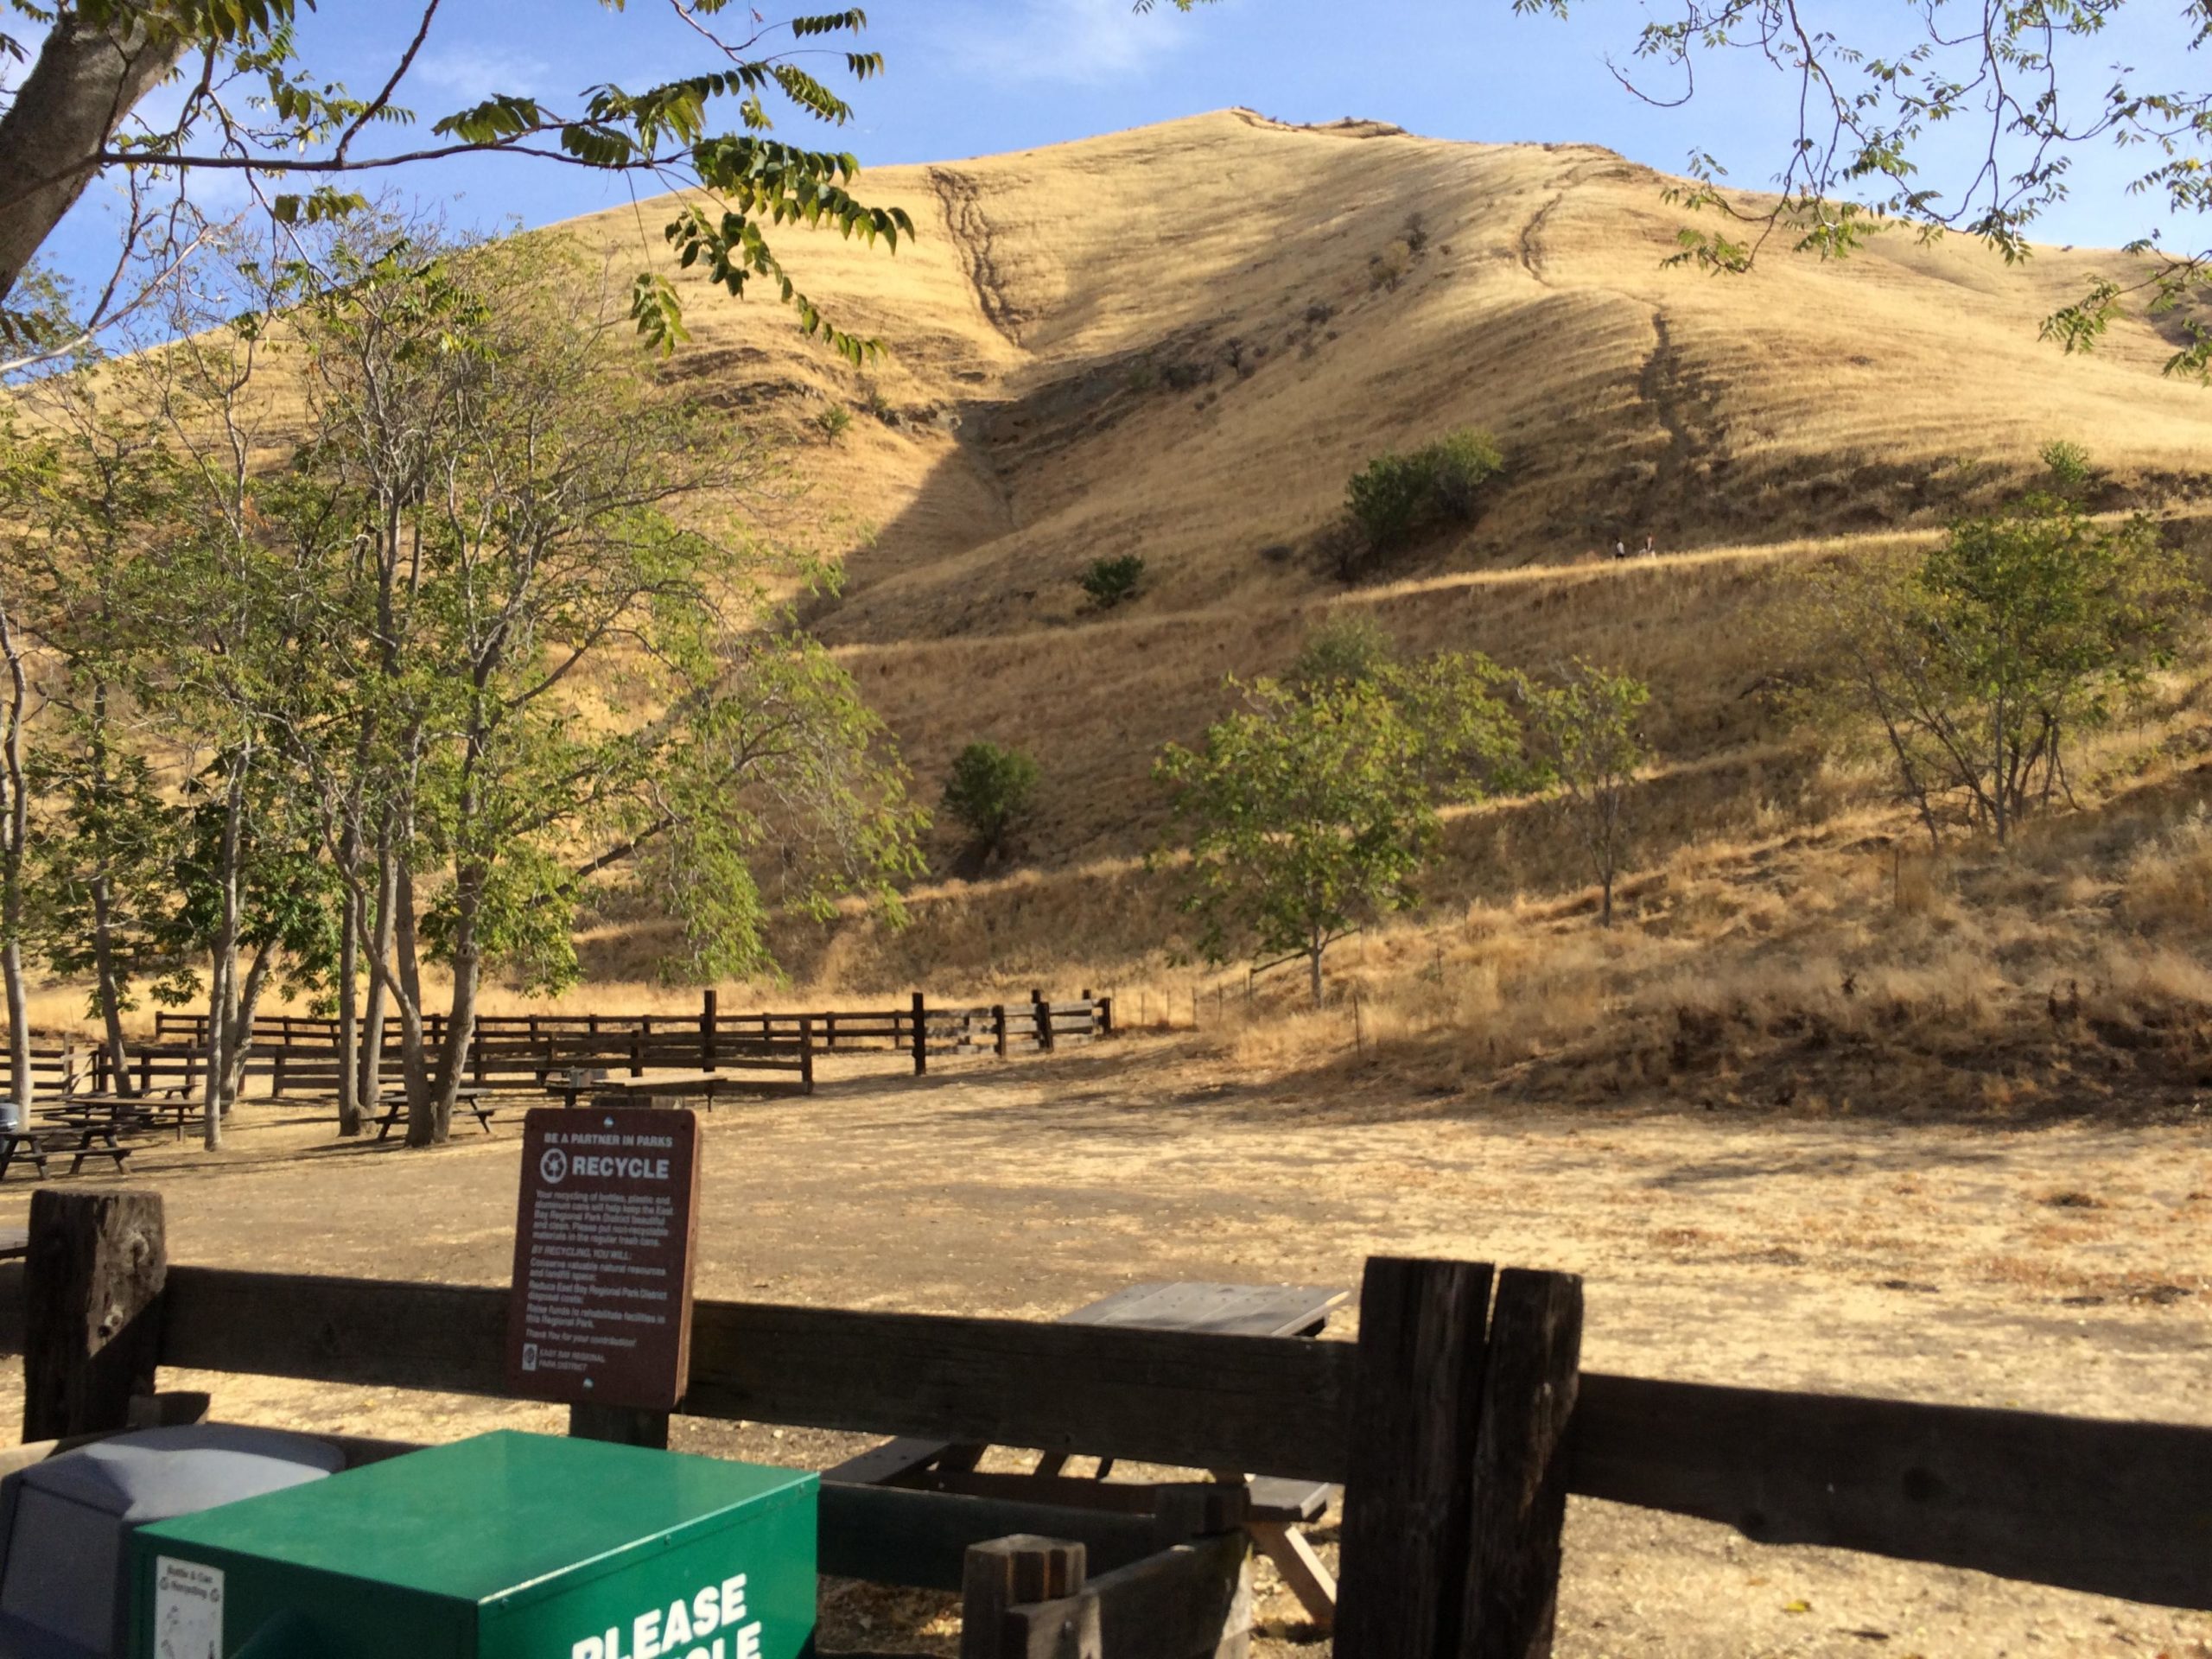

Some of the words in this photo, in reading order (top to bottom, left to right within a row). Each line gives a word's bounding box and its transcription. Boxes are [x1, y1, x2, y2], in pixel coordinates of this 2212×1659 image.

[543, 1132, 559, 1143] BE
[562, 1132, 569, 1143] A
[571, 1133, 620, 1146] PARTNER
[623, 1134, 634, 1146] IN
[637, 1135, 673, 1147] PARKS
[572, 1156, 670, 1179] RECYCLE
[554, 1192, 588, 1202] recycling
[531, 1244, 543, 1255] BY
[593, 1249, 610, 1259] YOU
[572, 1333, 589, 1344] your
